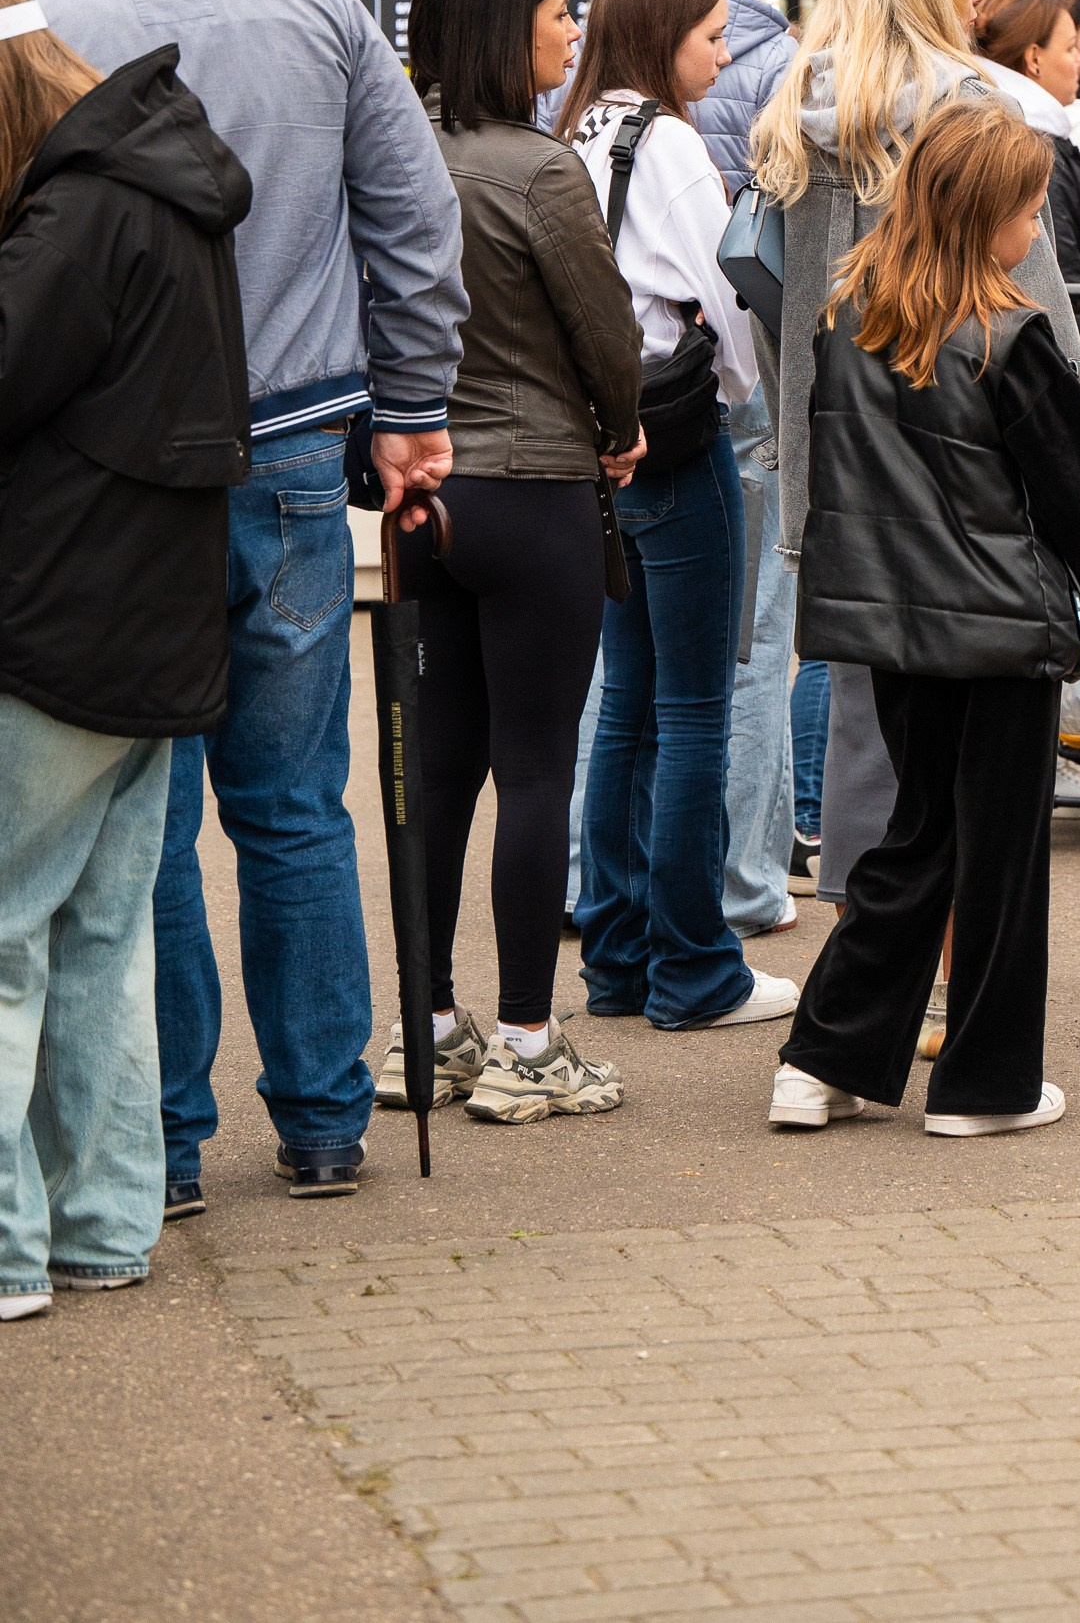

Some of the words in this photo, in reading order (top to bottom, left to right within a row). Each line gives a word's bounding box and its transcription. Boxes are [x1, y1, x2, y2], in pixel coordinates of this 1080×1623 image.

[391, 702, 403, 738] АКАДЕМИЯ
[393, 741, 404, 776] ДУХОВНАЯ
[394, 780, 406, 825] МОСКОВСКАЯ
[517, 1064, 535, 1079] FILA
